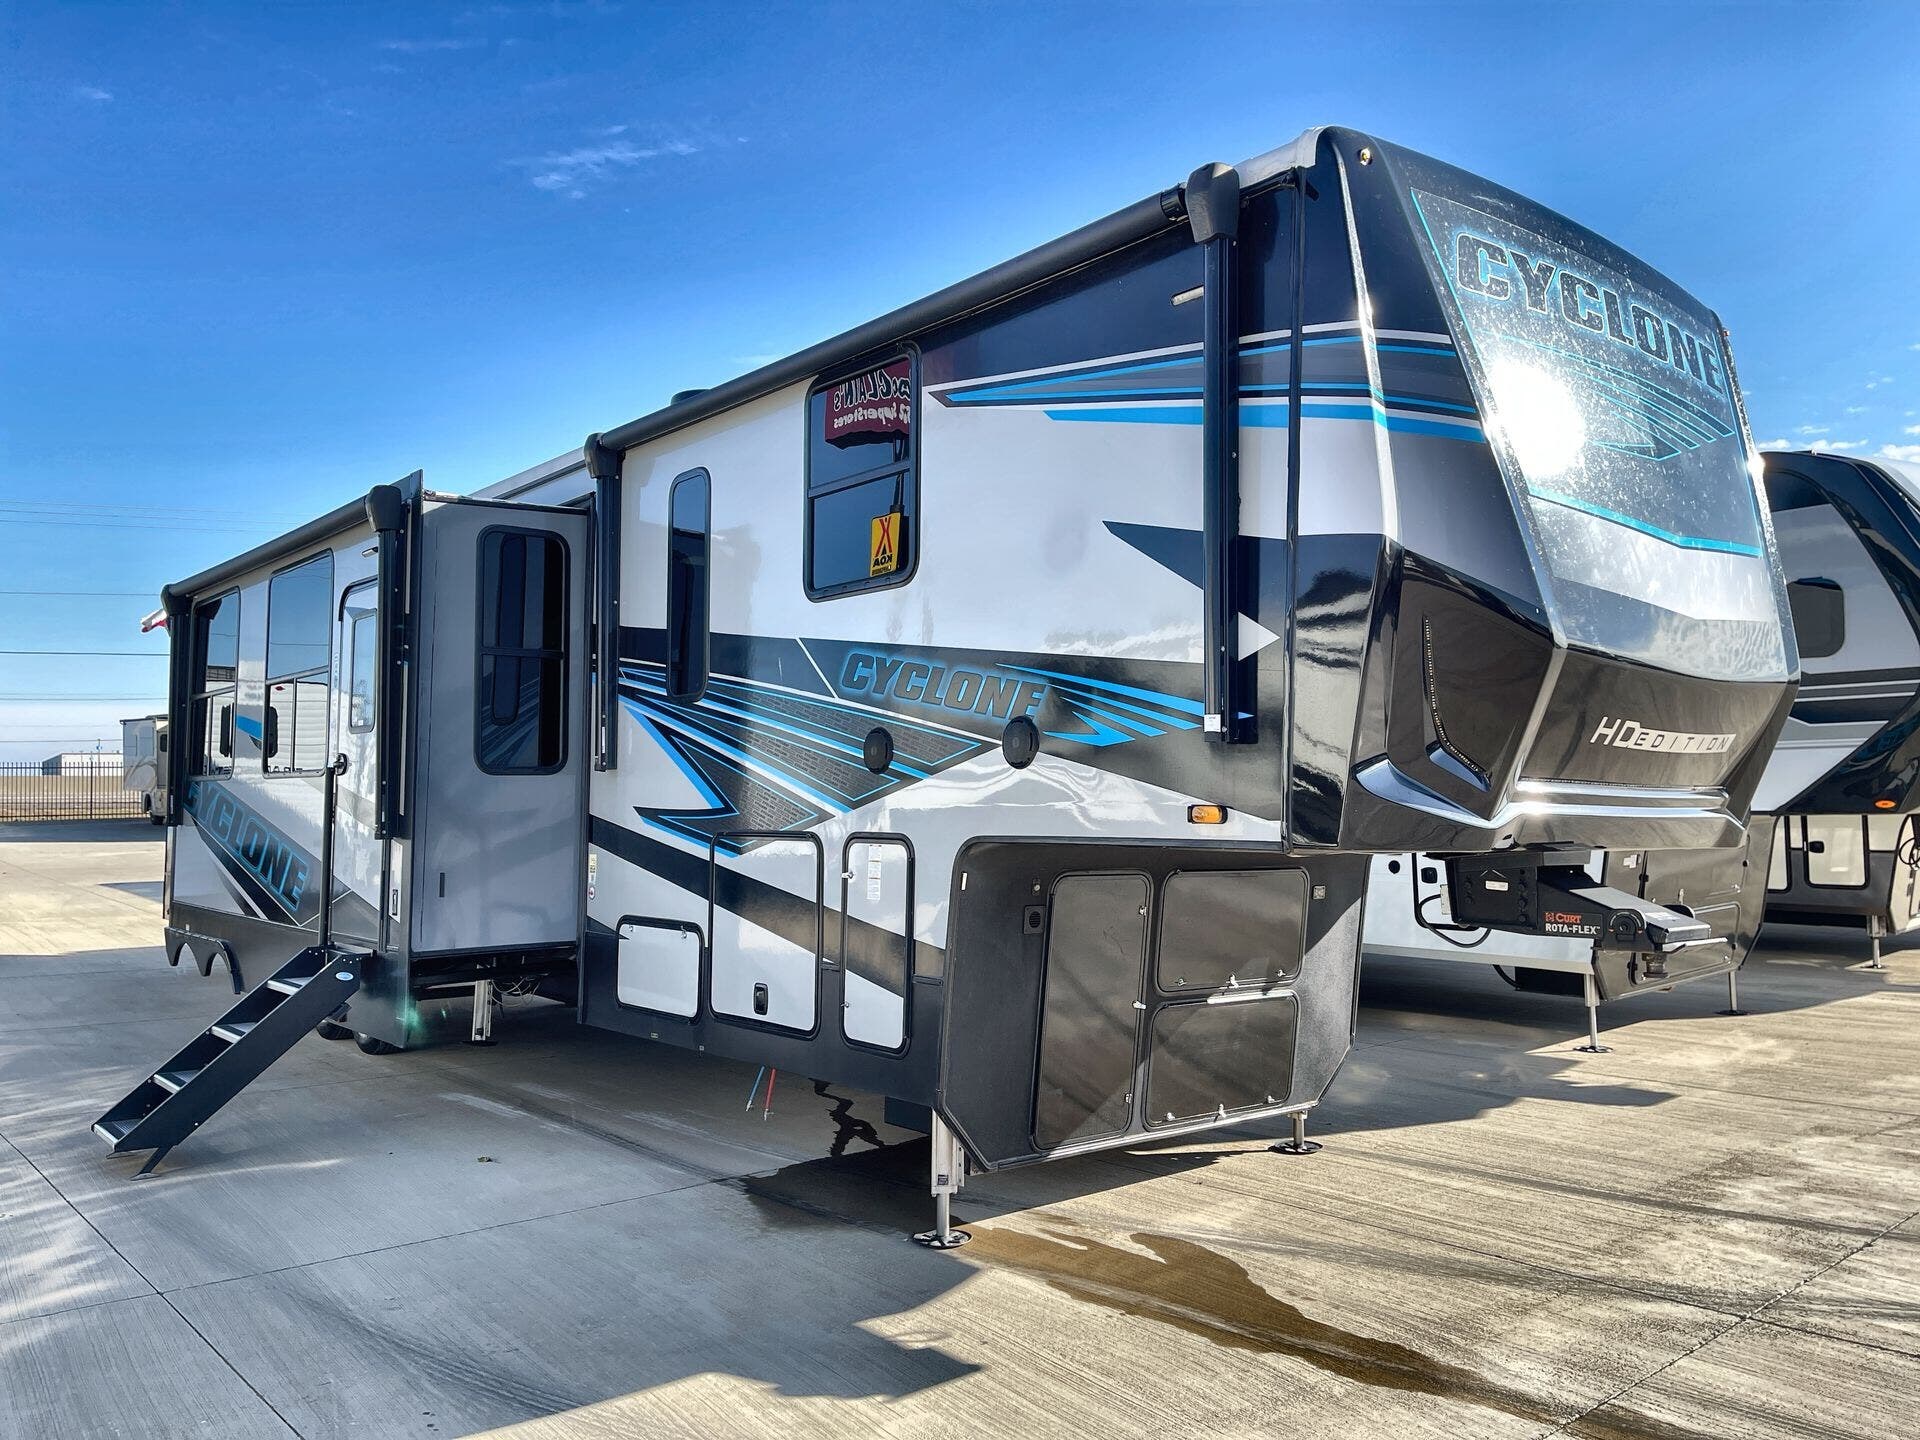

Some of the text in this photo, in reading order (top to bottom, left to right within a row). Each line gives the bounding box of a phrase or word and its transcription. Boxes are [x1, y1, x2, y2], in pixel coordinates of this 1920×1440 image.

[1456, 232, 1724, 393] CYCLONE
[841, 652, 1048, 720] CYCLONE
[1589, 716, 1731, 751] HD EDITION
[1555, 912, 1582, 923] CURT
